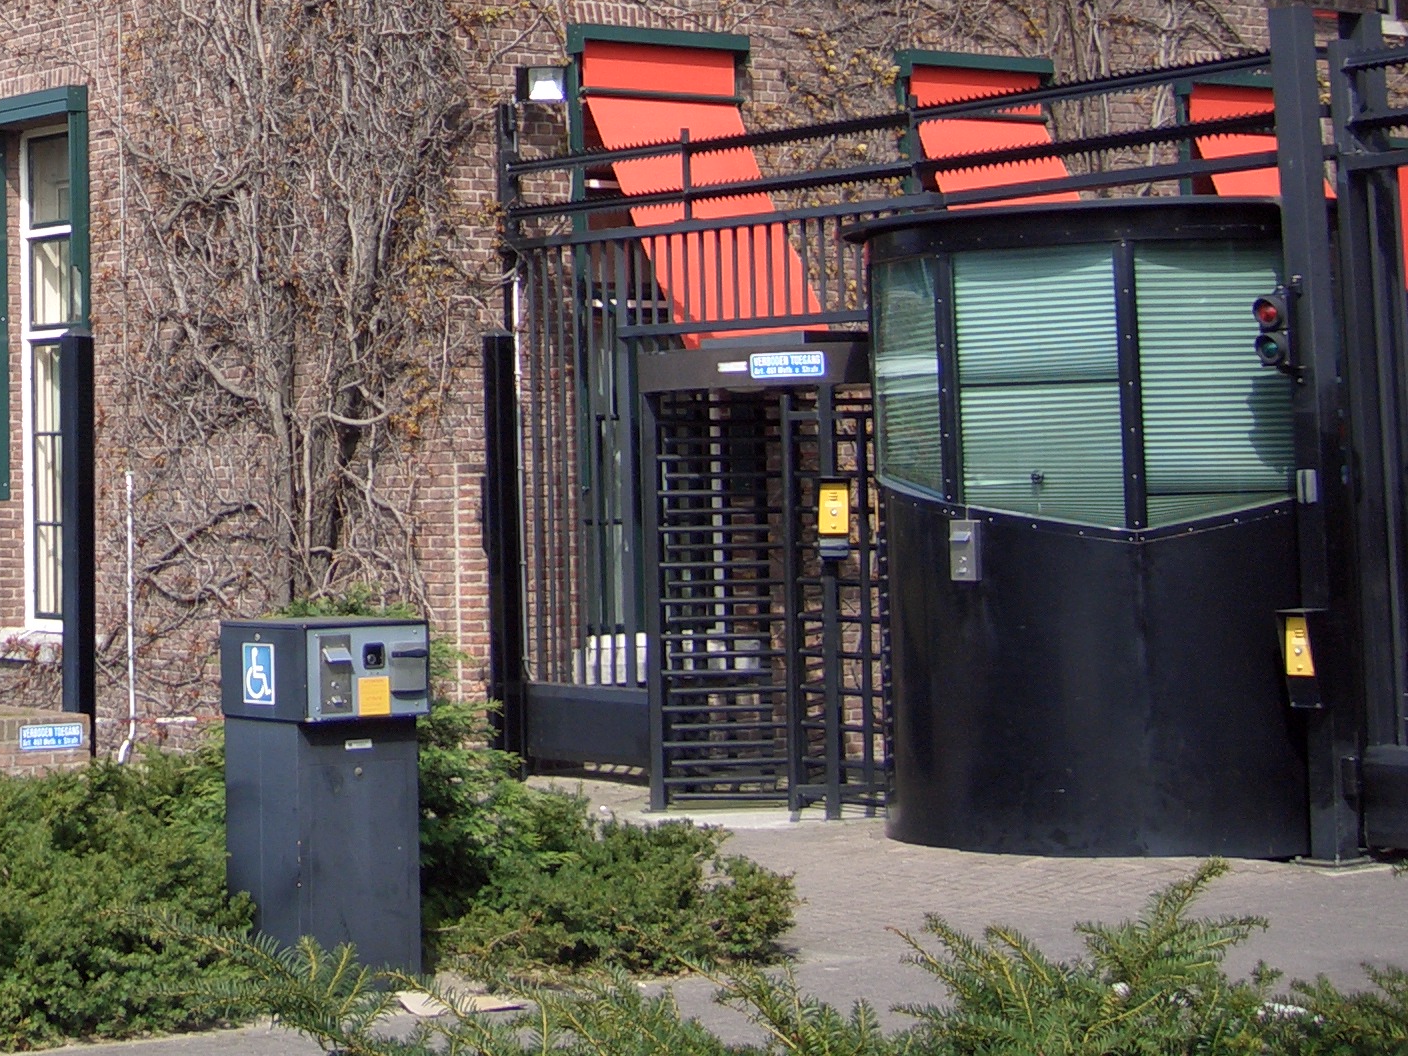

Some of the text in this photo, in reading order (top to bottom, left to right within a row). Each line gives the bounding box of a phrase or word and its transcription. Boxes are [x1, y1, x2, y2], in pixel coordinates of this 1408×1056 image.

[753, 354, 821, 367] VERBODEN TOEGANG
[22, 725, 80, 739] VERBODEN TOEGANG
